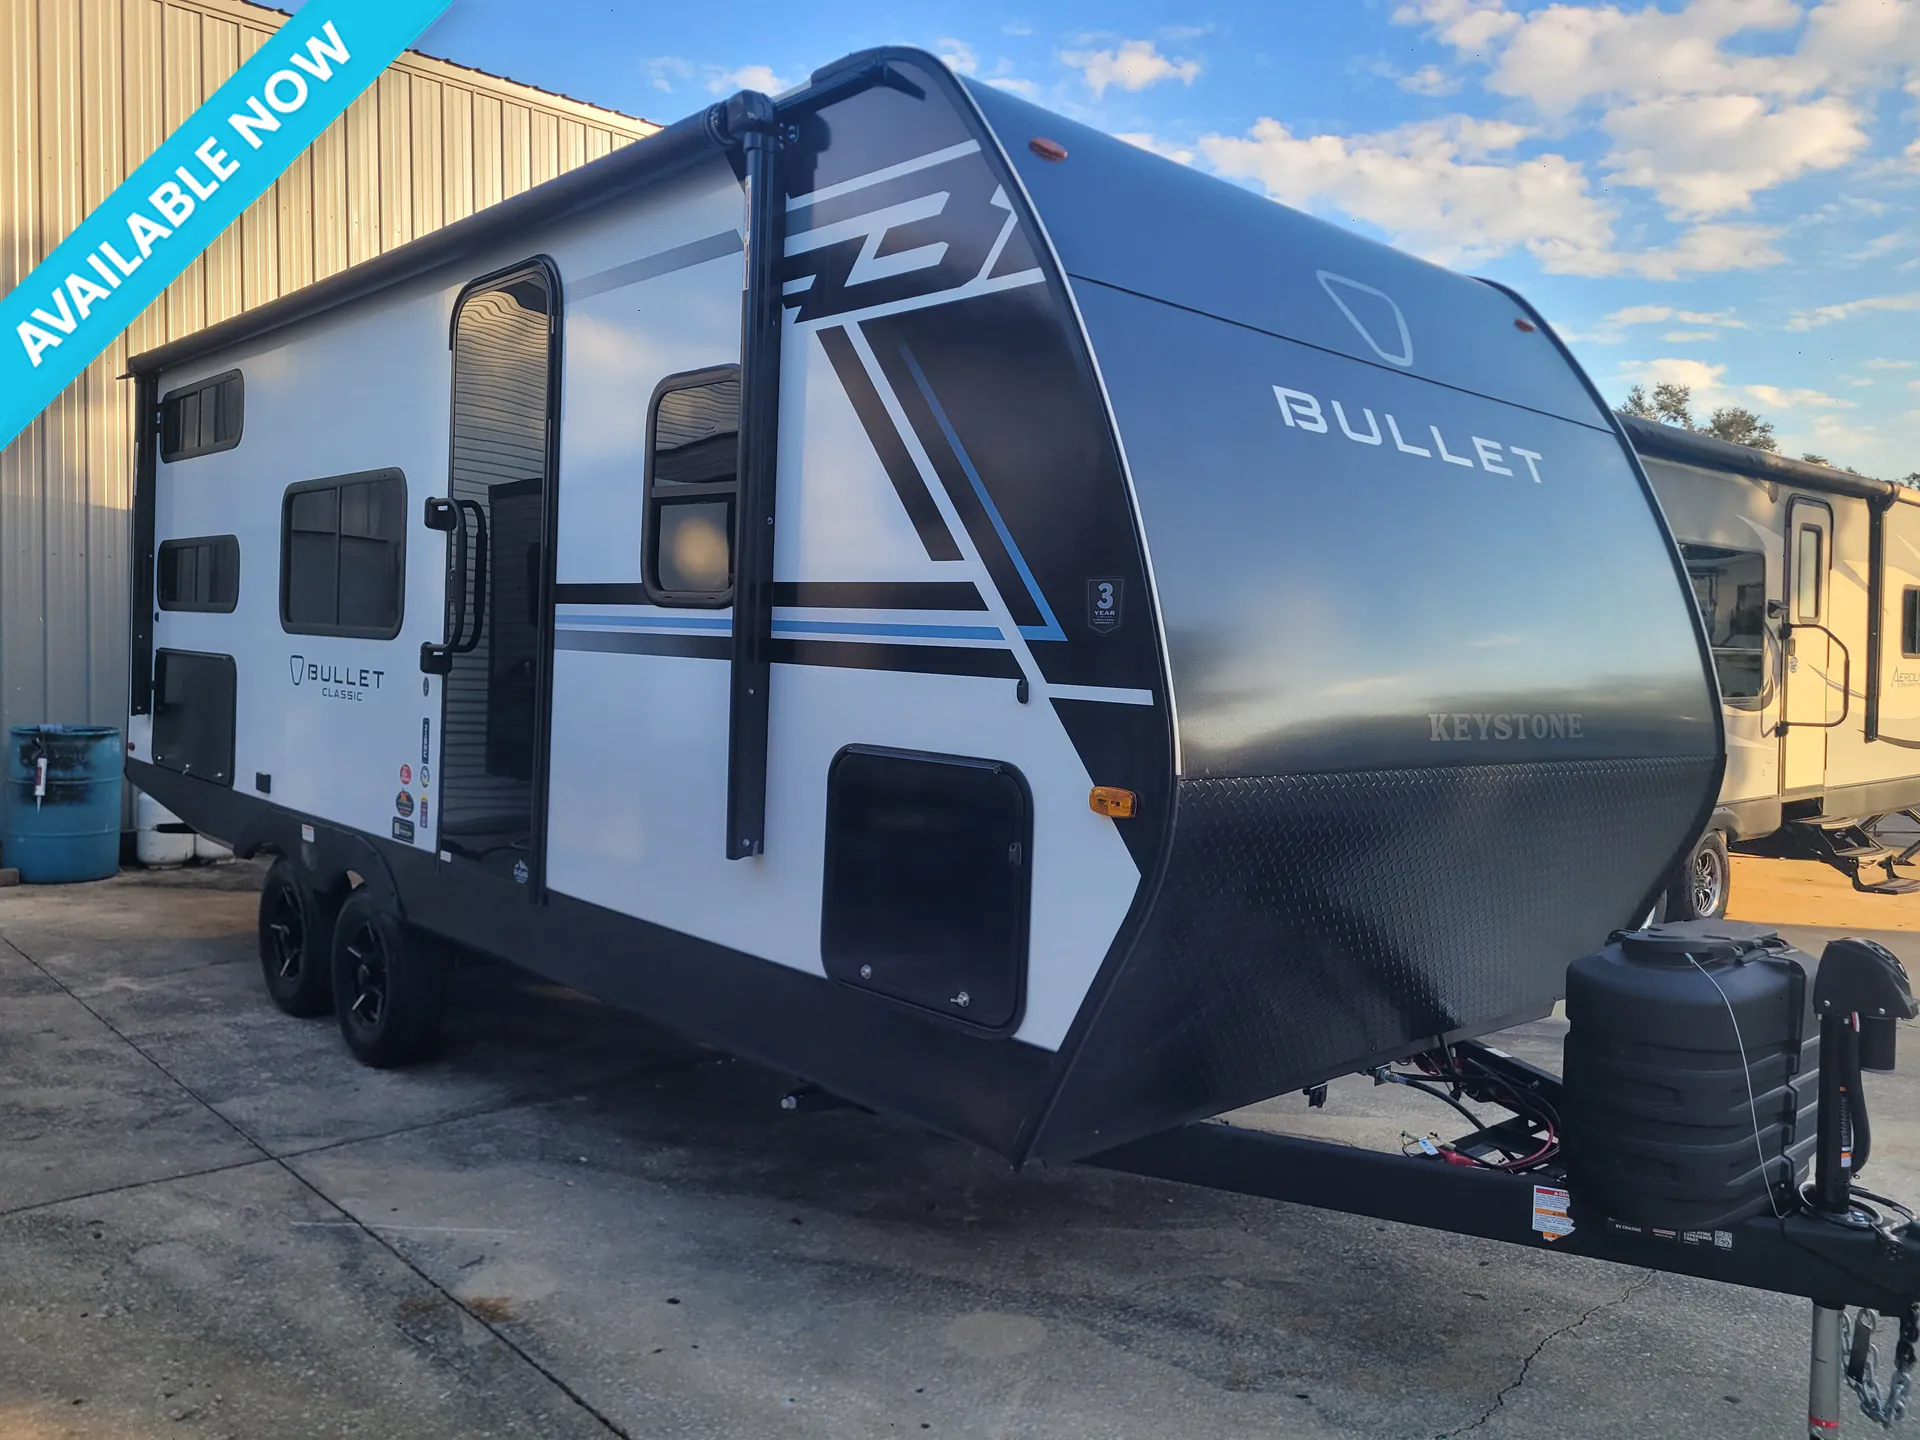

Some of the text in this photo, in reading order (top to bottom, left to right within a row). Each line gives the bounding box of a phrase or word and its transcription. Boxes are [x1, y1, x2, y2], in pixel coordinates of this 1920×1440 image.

[1272, 384, 1543, 484] BULLET
[1097, 582, 1114, 610] 3
[308, 663, 385, 689] BULLET
[1891, 666, 1920, 688] AEROL
[322, 687, 364, 702] CLASSIC
[1428, 713, 1584, 742] KEYSTONE
